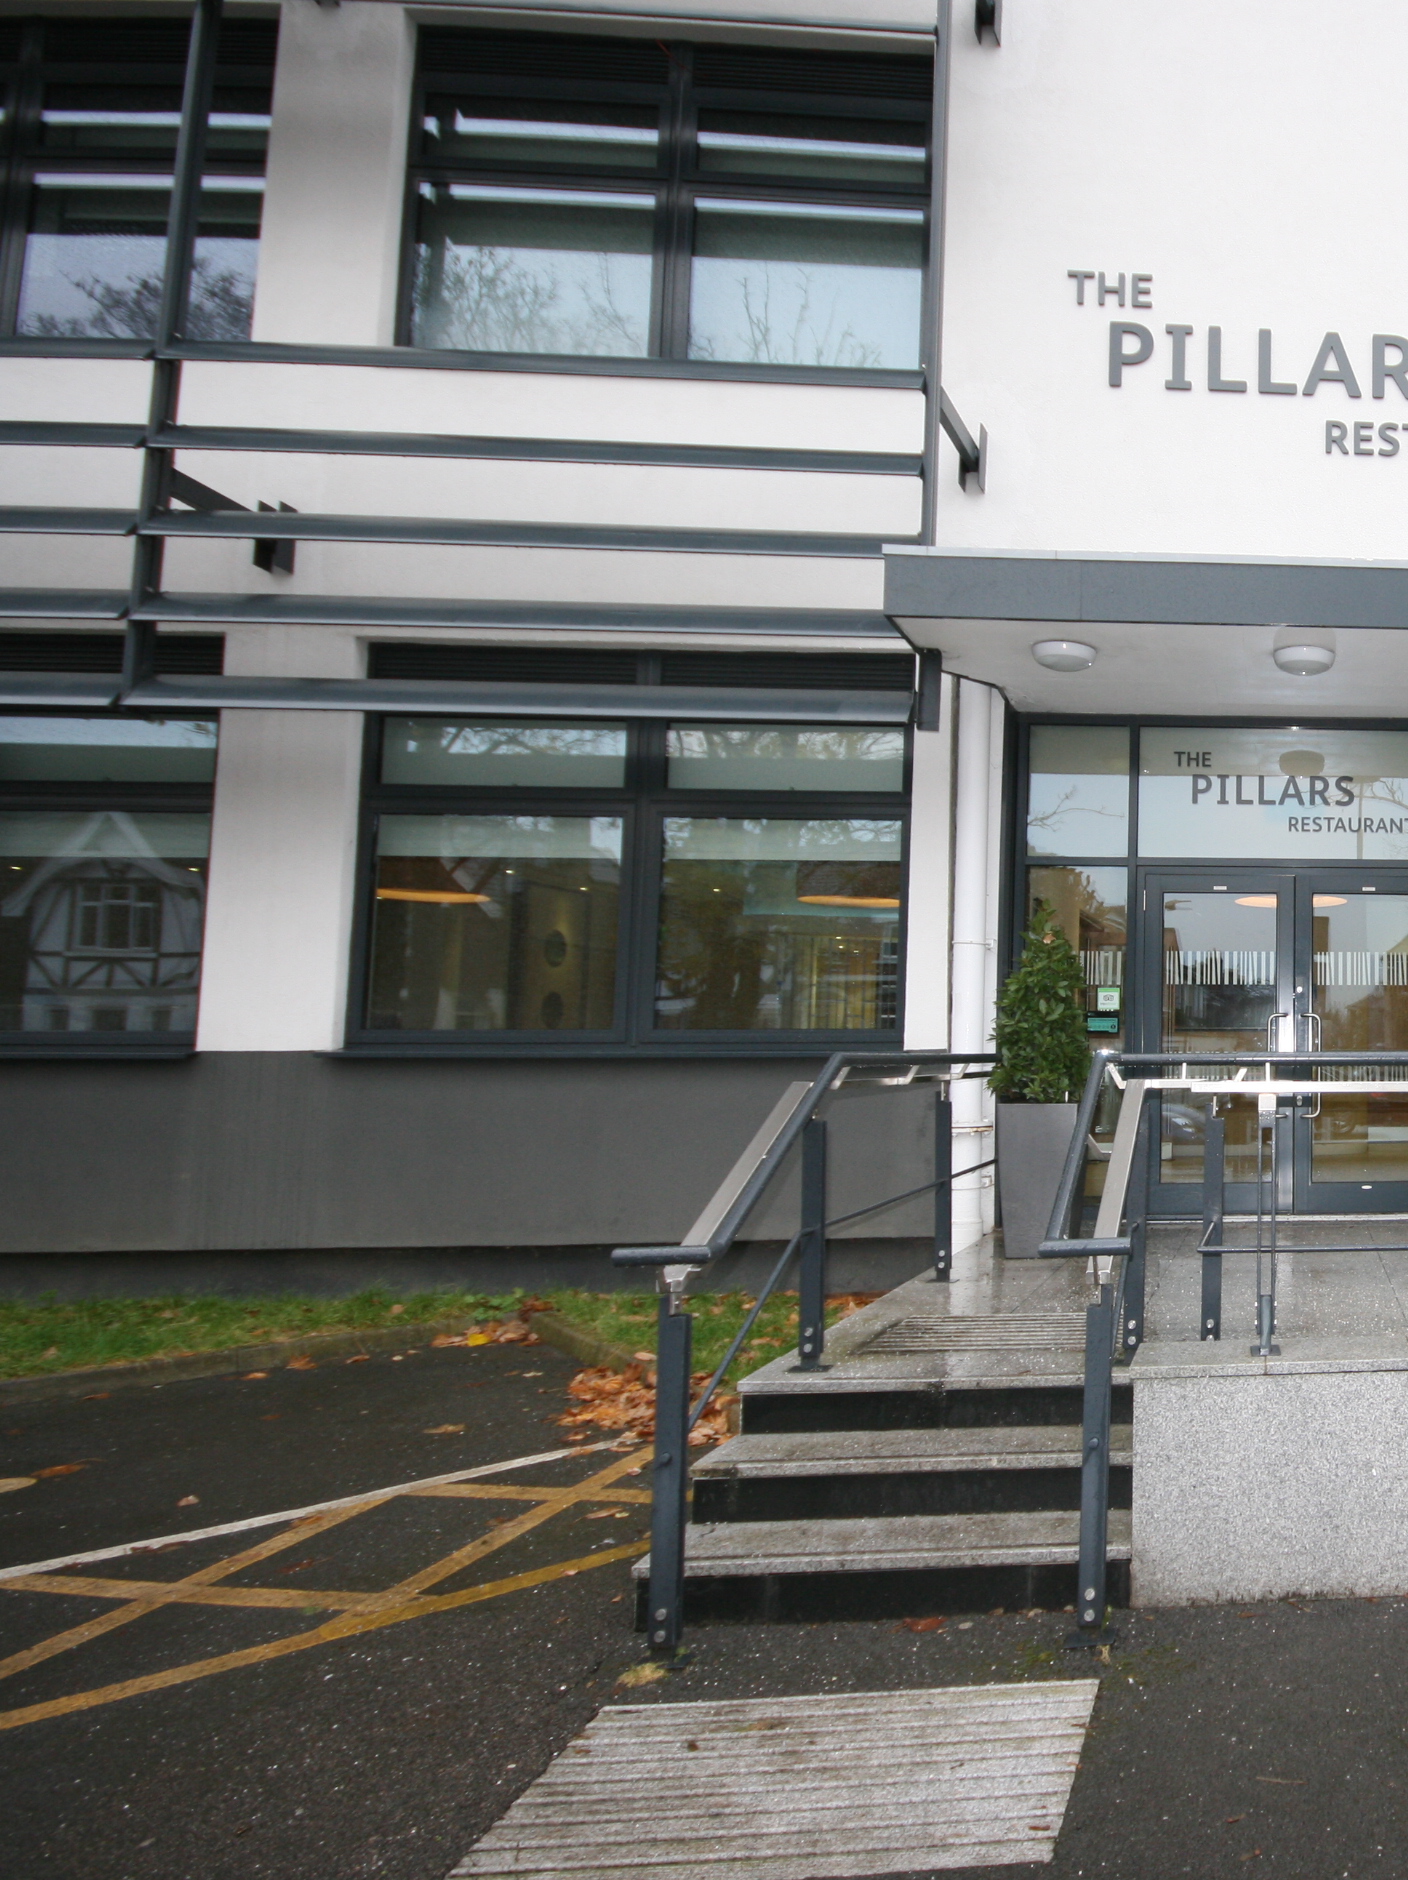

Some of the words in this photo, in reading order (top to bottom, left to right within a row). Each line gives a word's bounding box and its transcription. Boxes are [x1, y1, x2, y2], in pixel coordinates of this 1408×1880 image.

[1067, 269, 1153, 309] THE
[1173, 751, 1212, 768] THE
[1191, 774, 1355, 806] PILLARS
